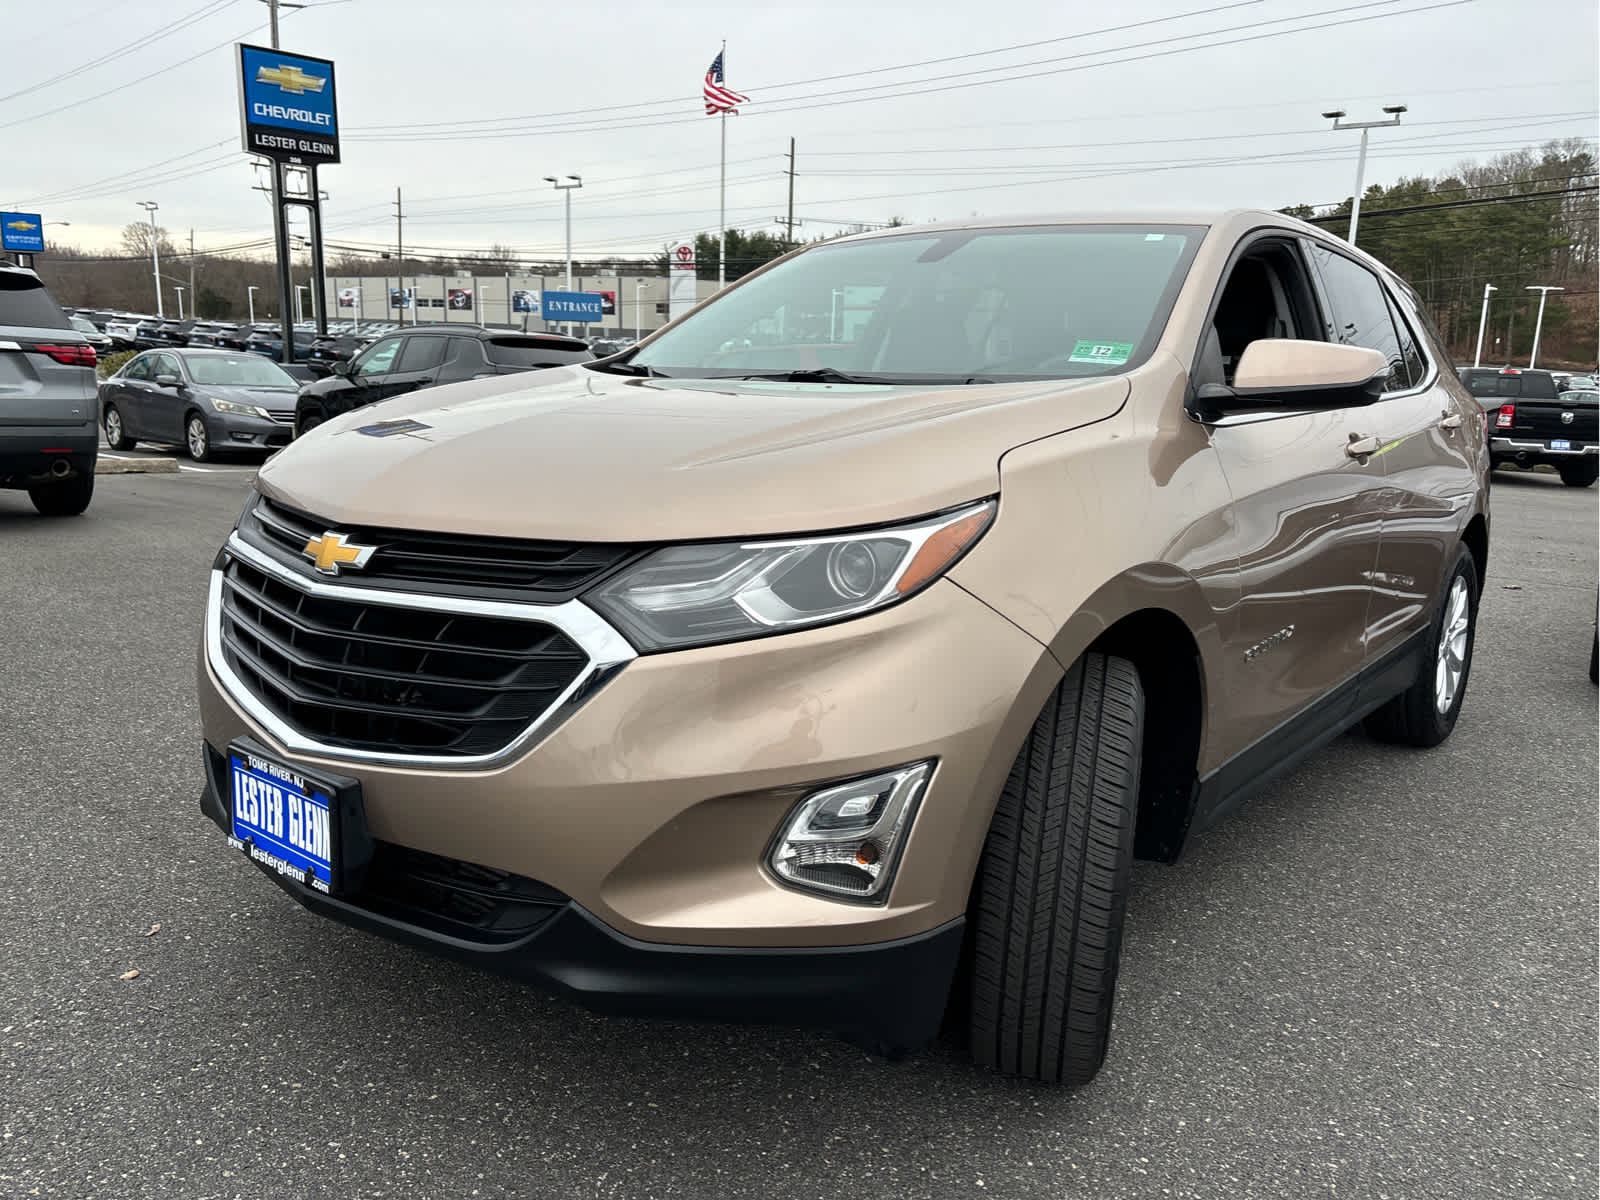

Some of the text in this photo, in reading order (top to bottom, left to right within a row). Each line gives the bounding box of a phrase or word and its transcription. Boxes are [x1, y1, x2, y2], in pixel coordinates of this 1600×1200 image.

[254, 102, 331, 126] CHEVROLET
[255, 133, 335, 156] LESTER GLENN
[548, 300, 601, 313] ENTRANCE
[1093, 345, 1112, 356] 12
[248, 756, 268, 773] TOMS
[294, 775, 304, 788] NJ
[234, 771, 331, 863] LESTER GLENN
[250, 844, 305, 882] lesterglenn
